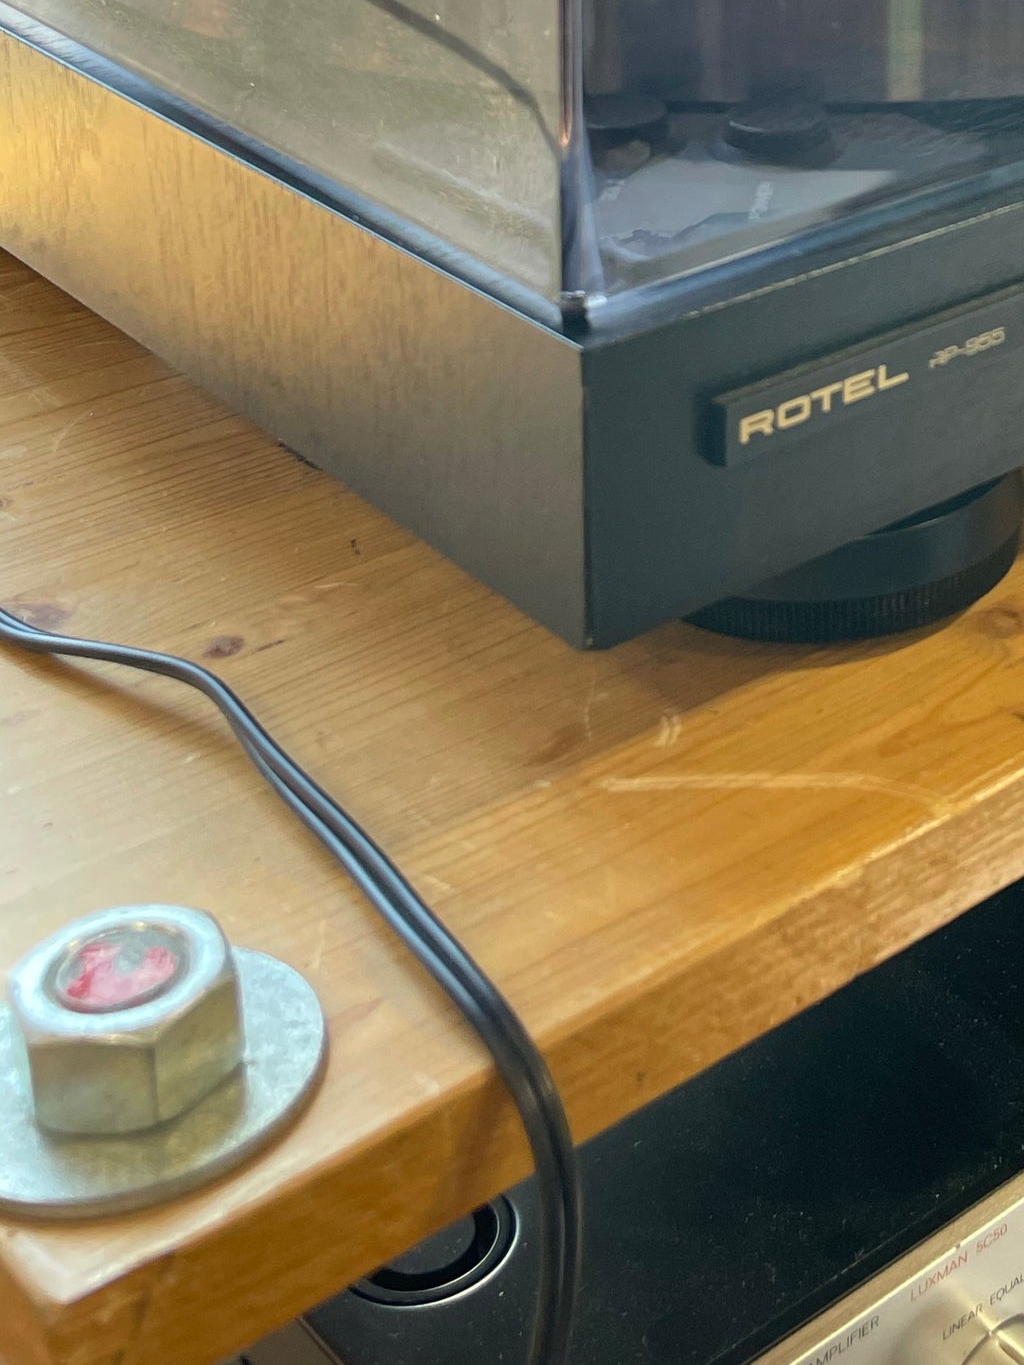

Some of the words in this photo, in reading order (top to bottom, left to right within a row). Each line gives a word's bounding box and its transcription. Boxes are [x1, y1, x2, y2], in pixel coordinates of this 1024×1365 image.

[739, 364, 910, 445] ROTEL
[910, 1250, 969, 1302] LUXMAN
[809, 1315, 881, 1365] MPLIFIER
[942, 1303, 984, 1340] LINEAR
